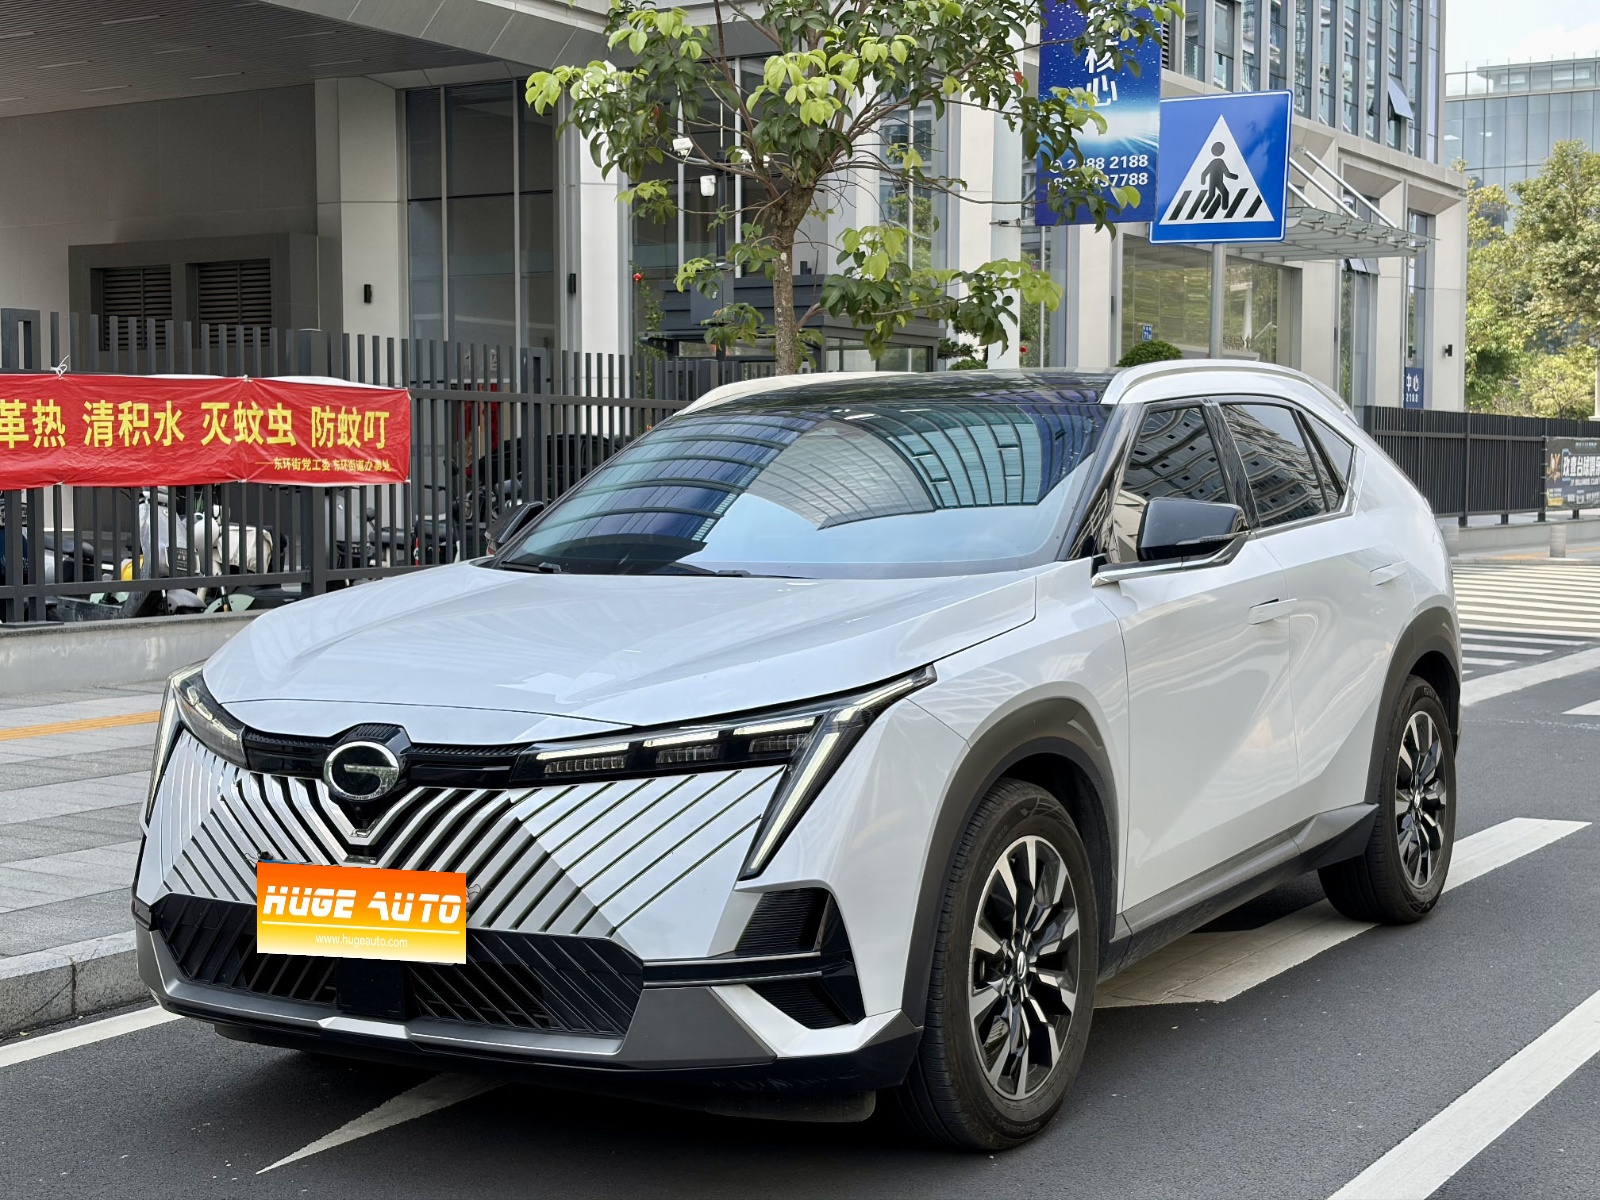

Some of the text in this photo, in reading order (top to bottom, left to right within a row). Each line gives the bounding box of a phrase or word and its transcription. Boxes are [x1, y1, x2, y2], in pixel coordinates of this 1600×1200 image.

[1067, 154, 1149, 171] 288 2188
[0, 398, 390, 450] 革热 清积水 灭蚊虫 防蚊叮
